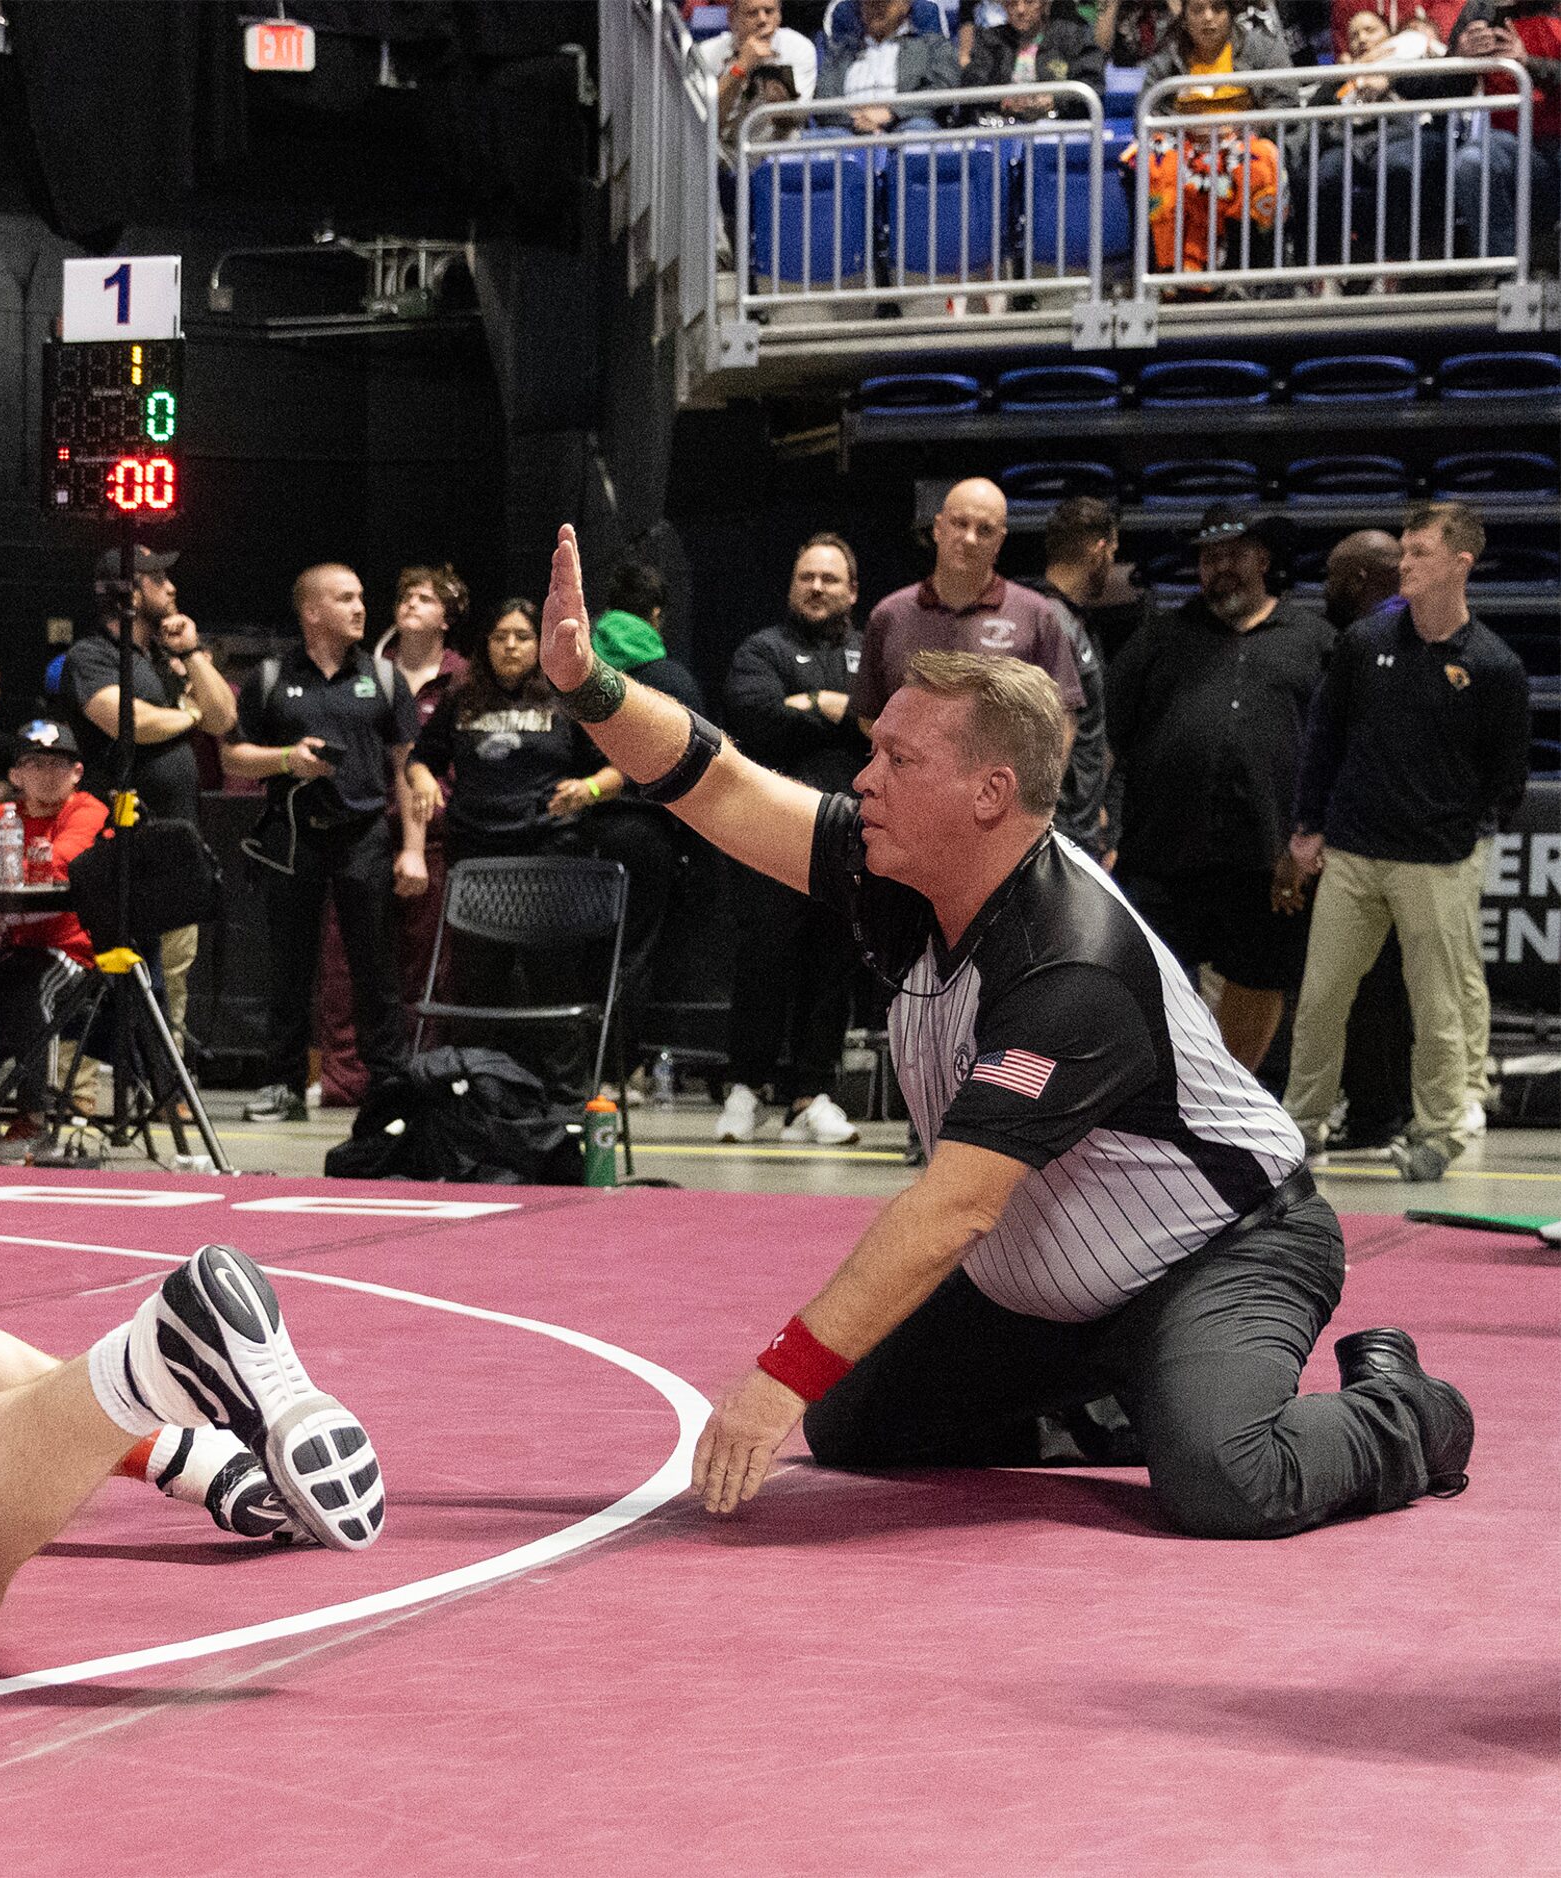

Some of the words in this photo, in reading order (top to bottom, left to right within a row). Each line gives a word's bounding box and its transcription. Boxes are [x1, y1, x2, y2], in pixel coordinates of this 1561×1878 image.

[258, 26, 305, 68] EXIT
[103, 263, 132, 325] 1
[131, 345, 143, 385] 1
[146, 391, 175, 441] 0
